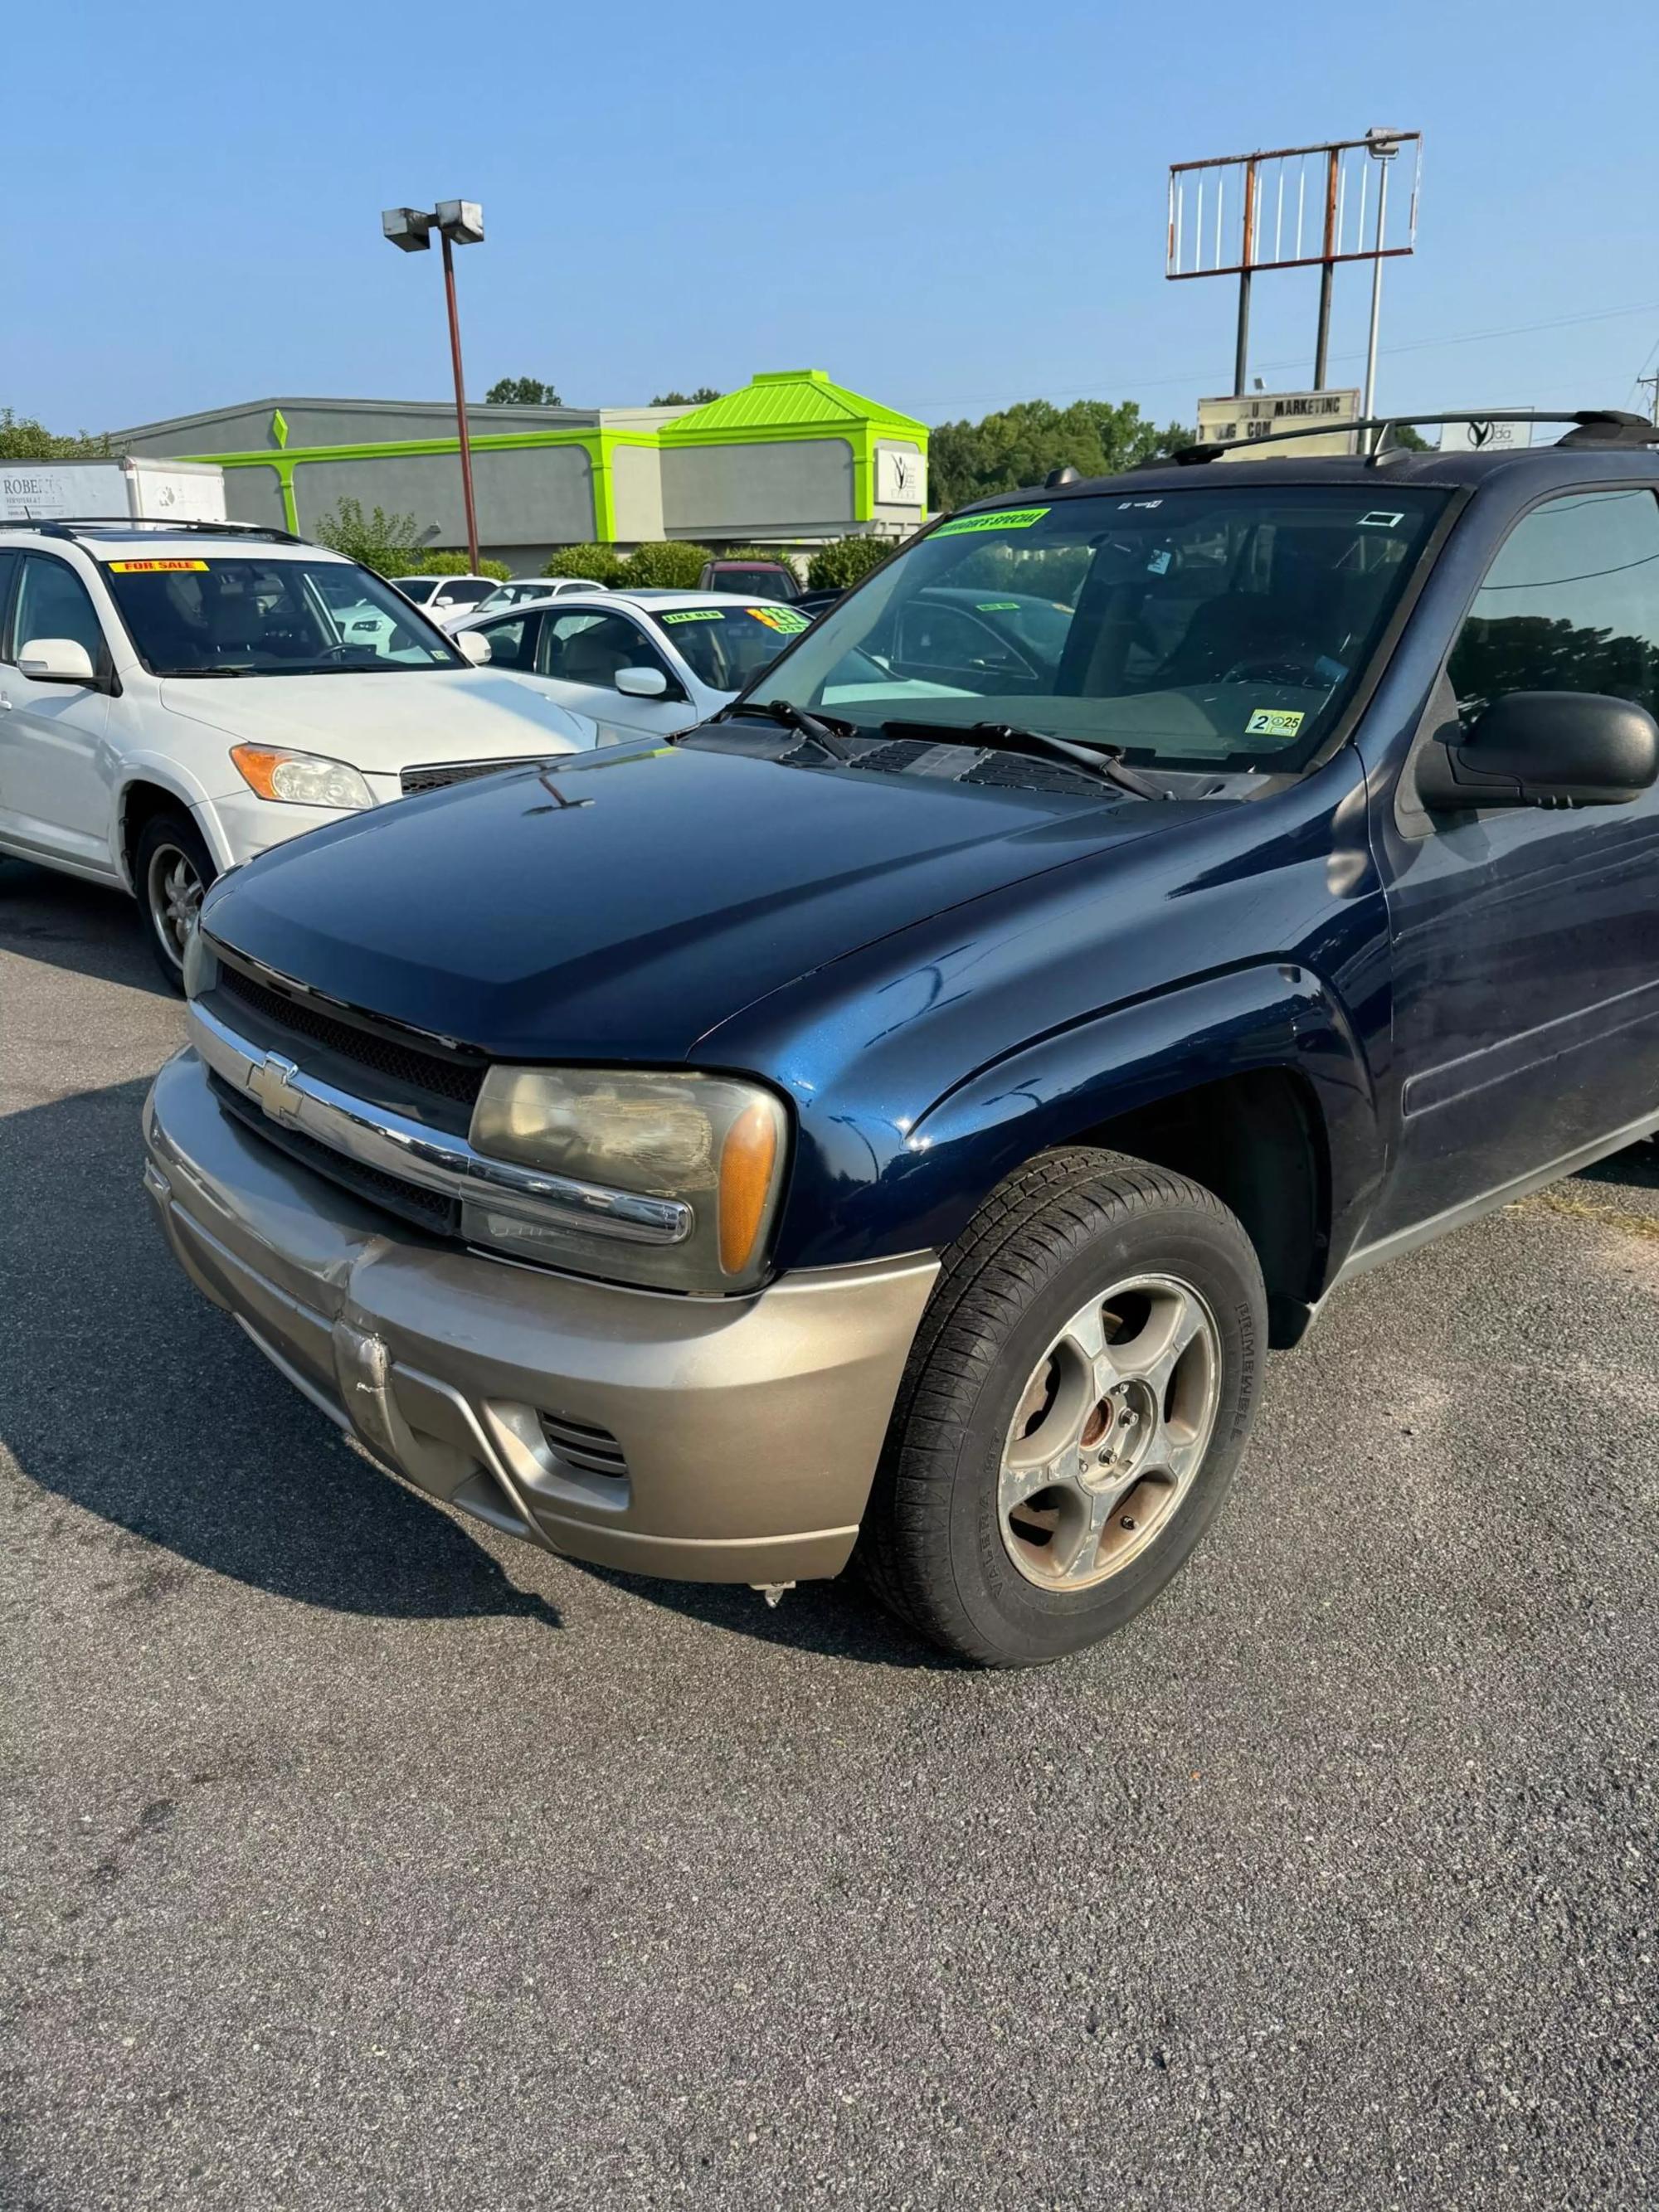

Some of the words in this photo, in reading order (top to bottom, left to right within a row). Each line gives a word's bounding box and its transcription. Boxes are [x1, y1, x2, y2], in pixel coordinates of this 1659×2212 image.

[124, 562, 153, 571] FOR
[158, 561, 193, 570] SALE
[666, 614, 693, 622] LIKE
[695, 612, 721, 620] NEW
[1253, 716, 1269, 730] 2
[1282, 717, 1301, 729] 25
[1230, 1300, 1254, 1442] PRIMEWELL
